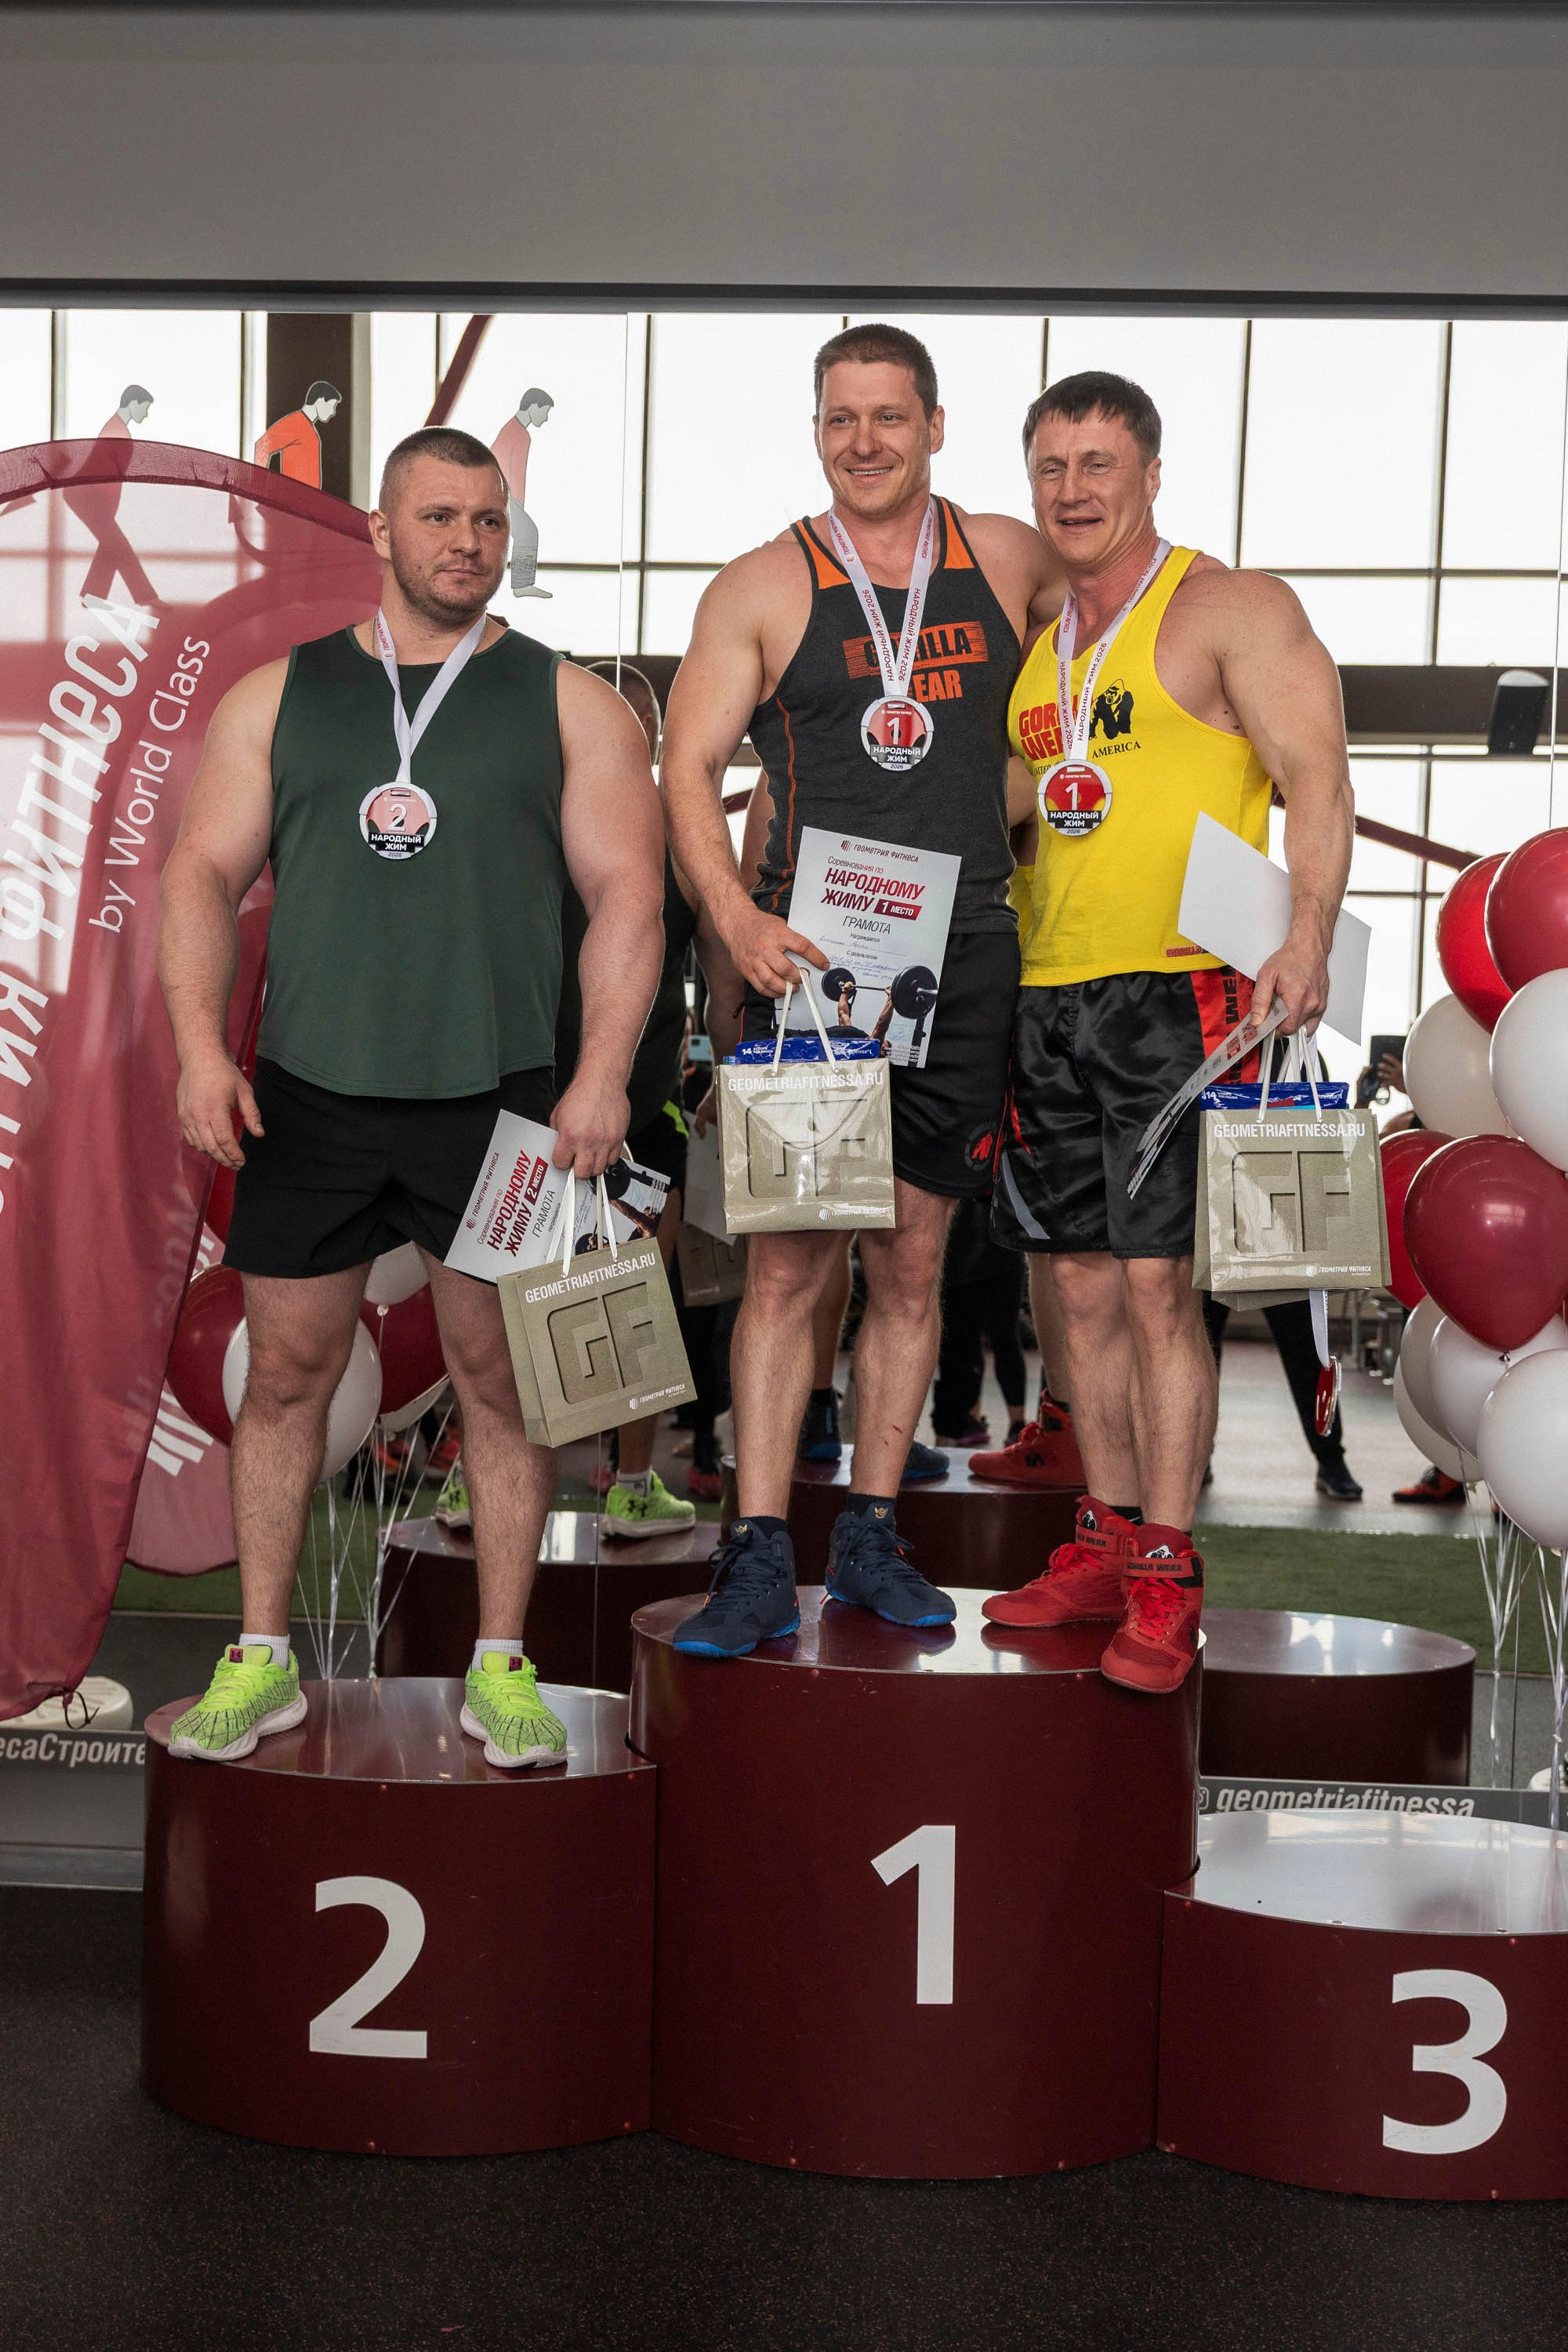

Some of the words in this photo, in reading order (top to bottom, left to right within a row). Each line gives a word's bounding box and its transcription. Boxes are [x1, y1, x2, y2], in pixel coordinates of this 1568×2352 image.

[862, 590, 875, 608] 2026
[906, 588, 921, 638] НАРОДНЫЙ
[869, 608, 882, 629] ЖИМ
[877, 630, 895, 681] НАРОДНЫЙ
[902, 637, 913, 660] ЖИМ
[149, 635, 211, 731] Class
[898, 660, 909, 681] 2026
[1060, 661, 1069, 706] НАРОДНЫЙ
[908, 670, 963, 703] EAR
[1078, 687, 1090, 741] НАРОДНЫЙ
[1087, 664, 1098, 685] ЖИМ
[1094, 642, 1107, 662] 2026
[887, 717, 900, 745] 1
[1062, 705, 1070, 728] ЖИМ
[873, 746, 921, 756] НАРОДНЫЙ
[1091, 740, 1142, 759] AMERICA
[104, 739, 172, 866] World
[1065, 782, 1078, 811] 1
[387, 803, 408, 833] 2
[1051, 811, 1099, 820] НАРОДНЫЙ
[371, 833, 422, 844] НАРОДНЫЙ
[385, 843, 408, 851] ЖИМ
[827, 855, 875, 873] Соревнования
[874, 866, 884, 875] по
[825, 867, 927, 901] НАРОДНОМУ
[89, 880, 136, 934] by
[820, 887, 876, 913] ЖИМУ
[881, 901, 889, 913] 1
[890, 905, 914, 916] МЕСТО
[842, 916, 891, 935] ГРАМОТА
[741, 1047, 752, 1056] 14
[728, 1072, 884, 1091] GEOMETRIAFITNESSA.RU
[1207, 1091, 1217, 1100] 14
[1214, 1123, 1366, 1138] GEOMETRIAFITNESSA.RU
[532, 1165, 544, 1189] МЕСТО
[487, 1149, 532, 1250] НАРОДНОМУ
[527, 1187, 538, 1200] 2
[477, 1199, 500, 1245] Соревнования
[495, 1189, 503, 1201] по
[532, 1189, 556, 1238] ГРАМОТА
[504, 1201, 532, 1258] ЖИМУ
[524, 1252, 656, 1303] GEOMETRIAFITNESSA.RU
[1216, 1787, 1475, 1817] geometriafitnessa
[870, 1824, 956, 2005] 1
[308, 1875, 429, 2060] 2
[1381, 1968, 1509, 2155] 3
